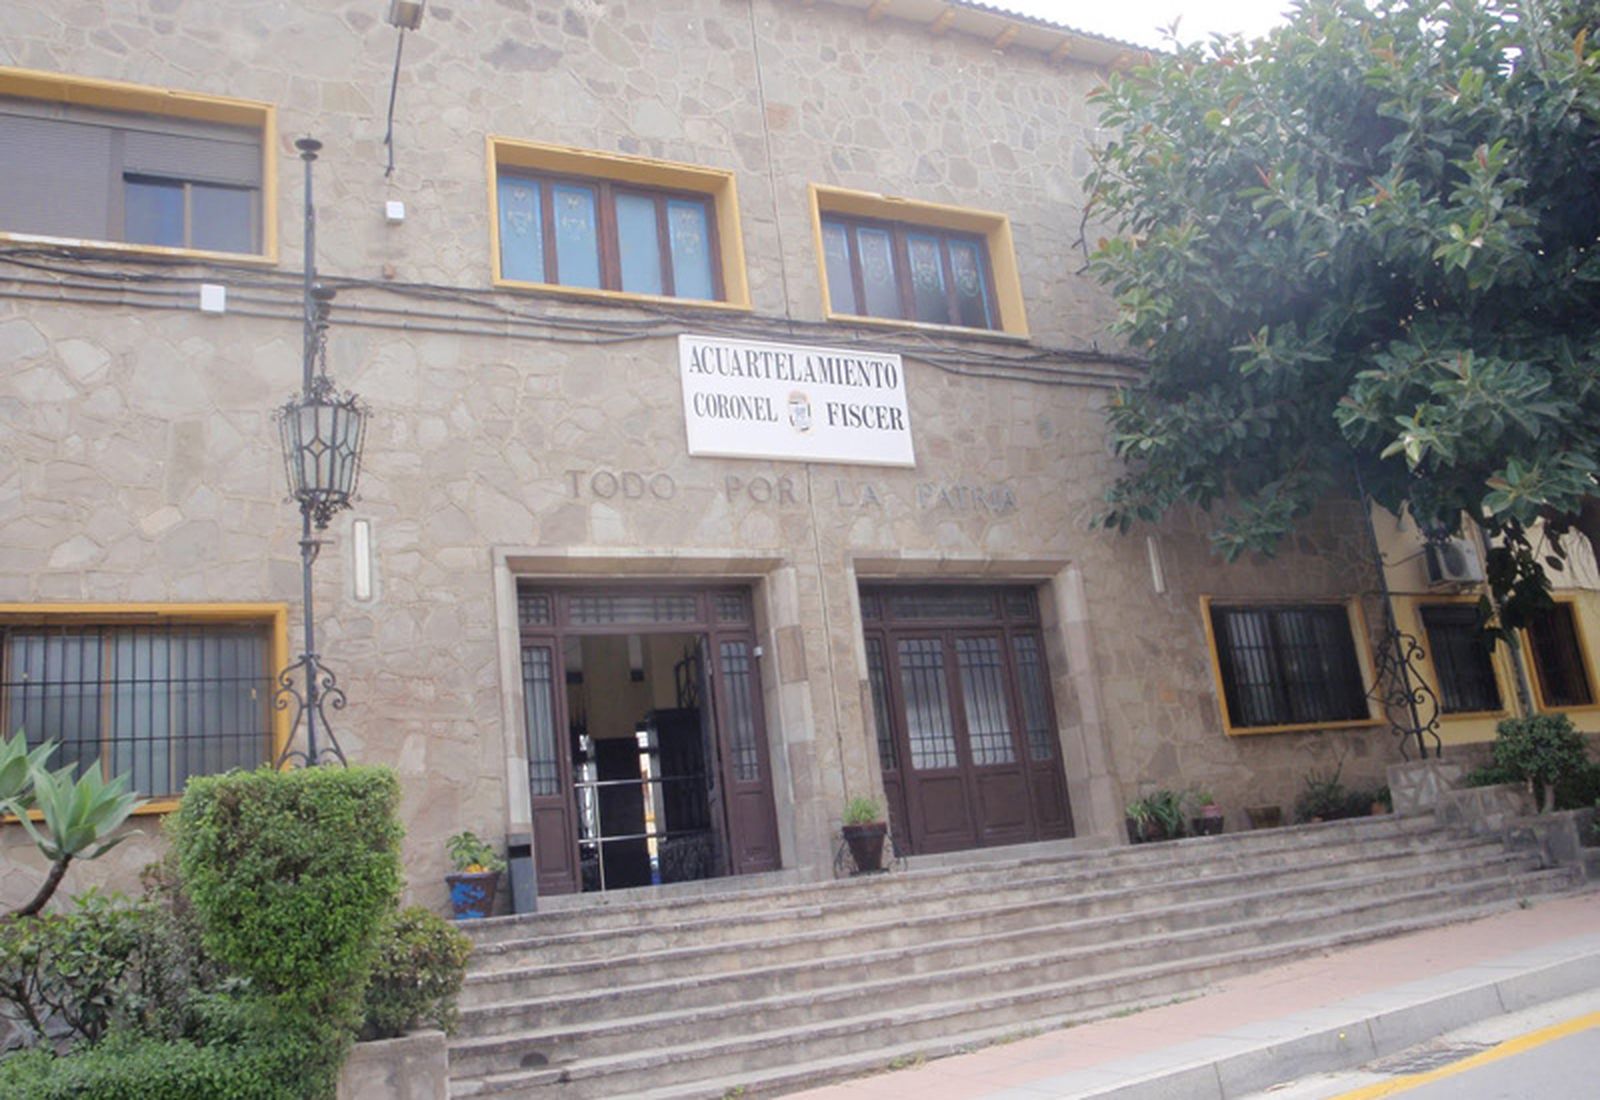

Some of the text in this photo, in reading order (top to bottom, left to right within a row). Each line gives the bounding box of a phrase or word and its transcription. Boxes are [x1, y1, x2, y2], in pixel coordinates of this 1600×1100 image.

[688, 345, 898, 389] ACUARTELAMIENTO
[693, 391, 905, 431] CORONEL FISCER
[564, 469, 1019, 512] TODO POR LA PATRIA
